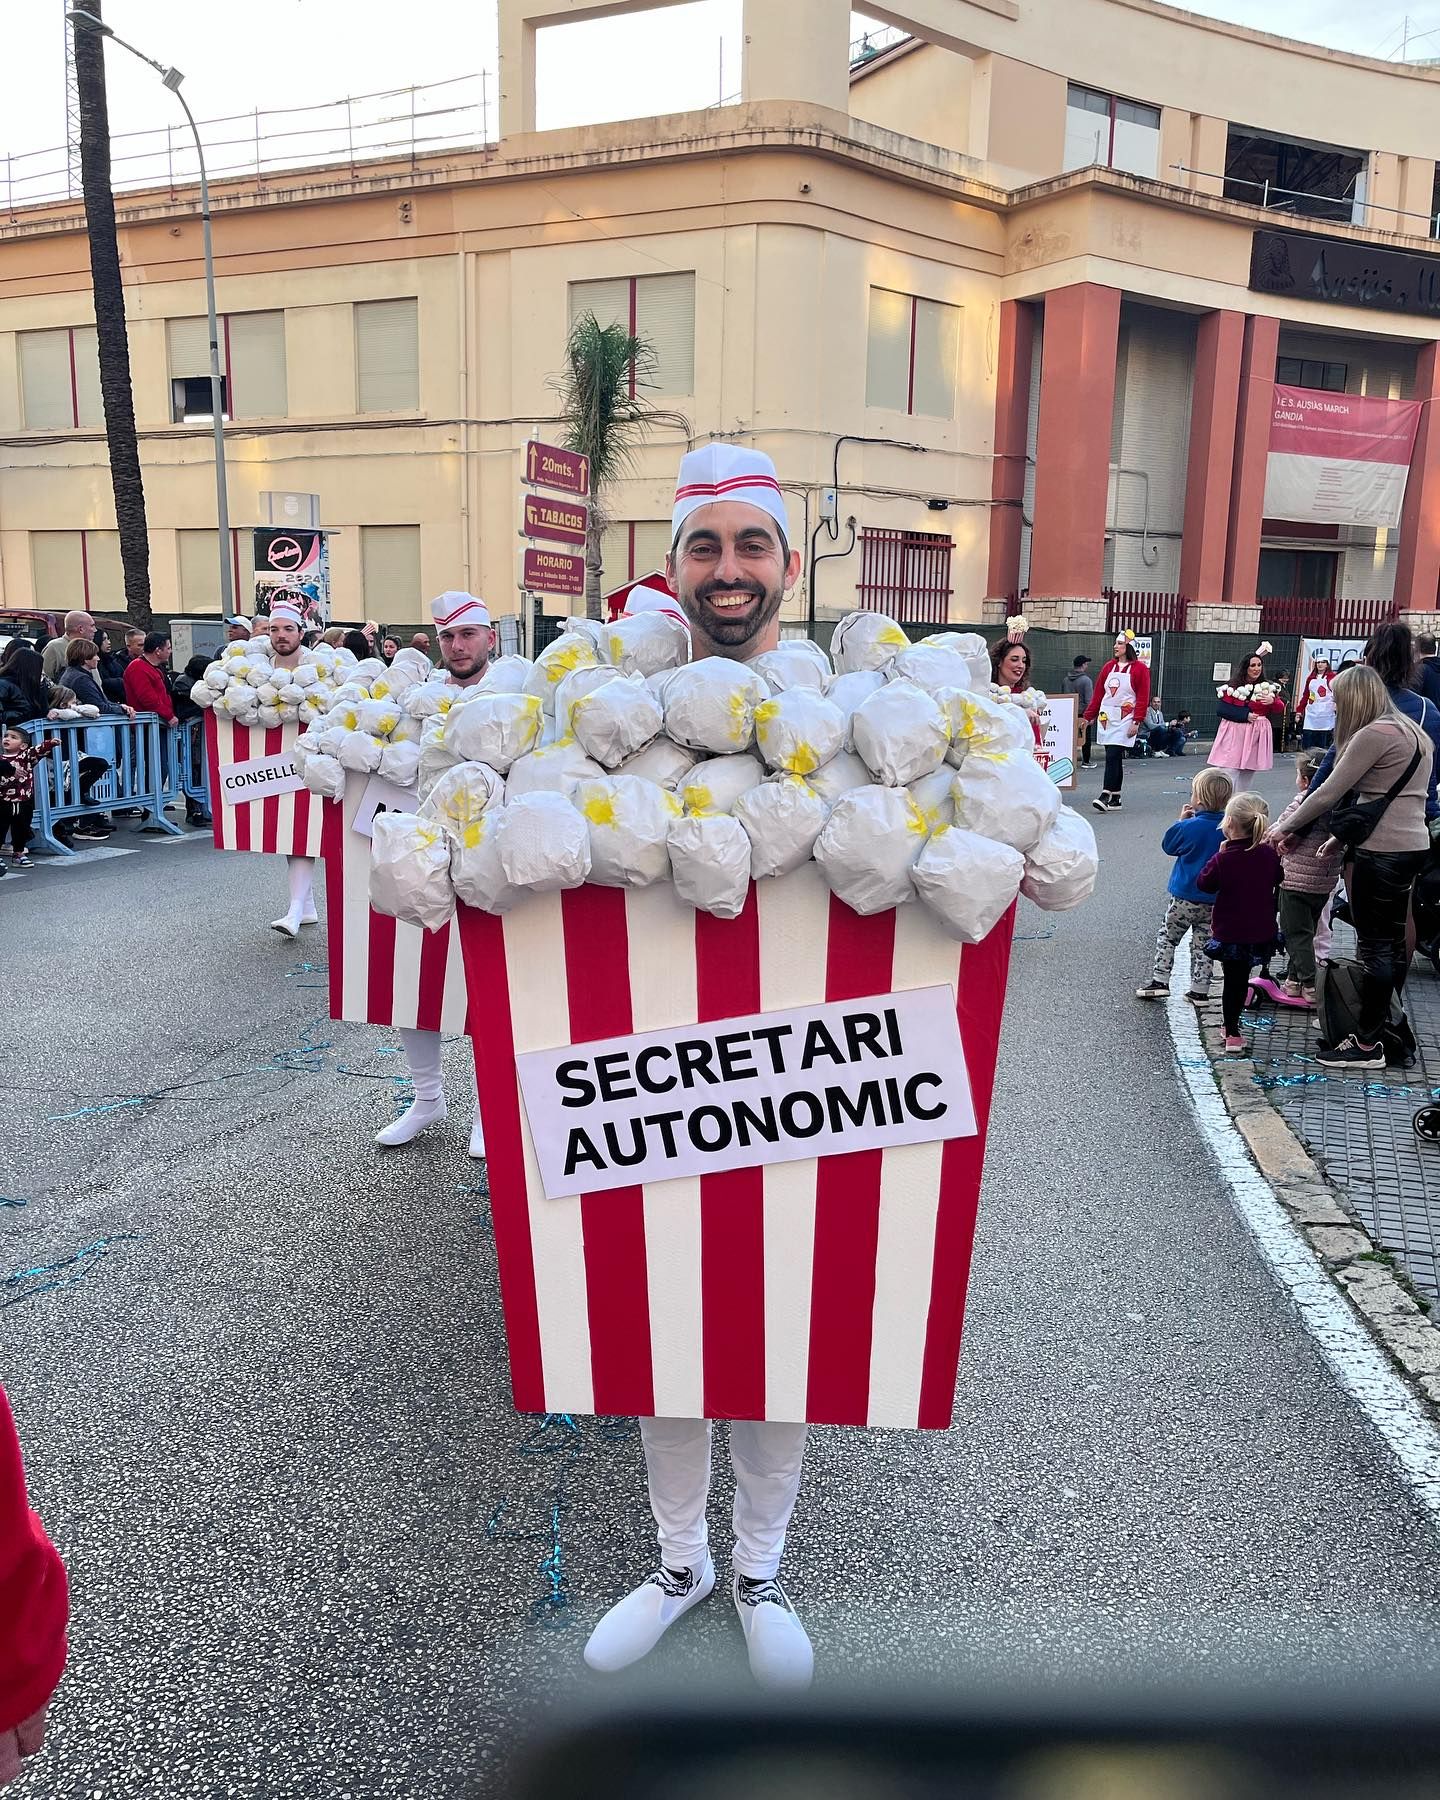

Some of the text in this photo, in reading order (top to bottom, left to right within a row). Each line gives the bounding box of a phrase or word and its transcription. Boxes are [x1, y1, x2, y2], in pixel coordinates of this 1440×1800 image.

[1274, 410, 1304, 421] GANDIA
[1324, 404, 1350, 414] MARCH
[541, 456, 574, 478] 20mts.
[540, 508, 582, 528] TABACOS
[536, 554, 573, 570] HORARIO
[285, 574, 321, 583] 2024
[225, 763, 298, 789] CONSELLE
[555, 1008, 903, 1108] SECRETARI
[563, 1072, 948, 1175] AUTONOMIC
